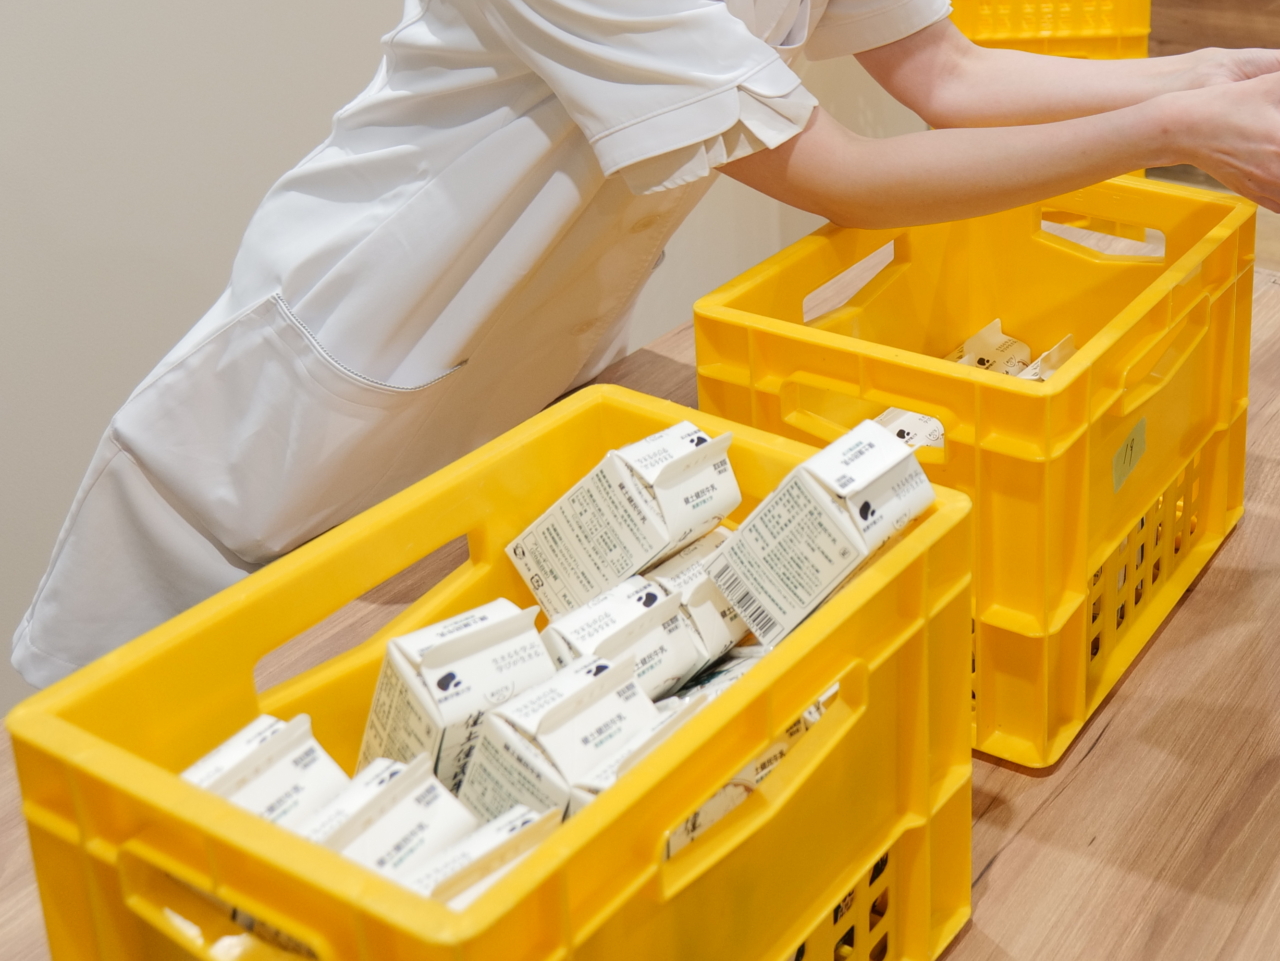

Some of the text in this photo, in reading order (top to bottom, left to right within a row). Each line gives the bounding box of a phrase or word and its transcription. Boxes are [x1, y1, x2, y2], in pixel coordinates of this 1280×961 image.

[683, 483, 718, 506] 健土健民牛乳
[634, 645, 668, 672] 土健民牛乳
